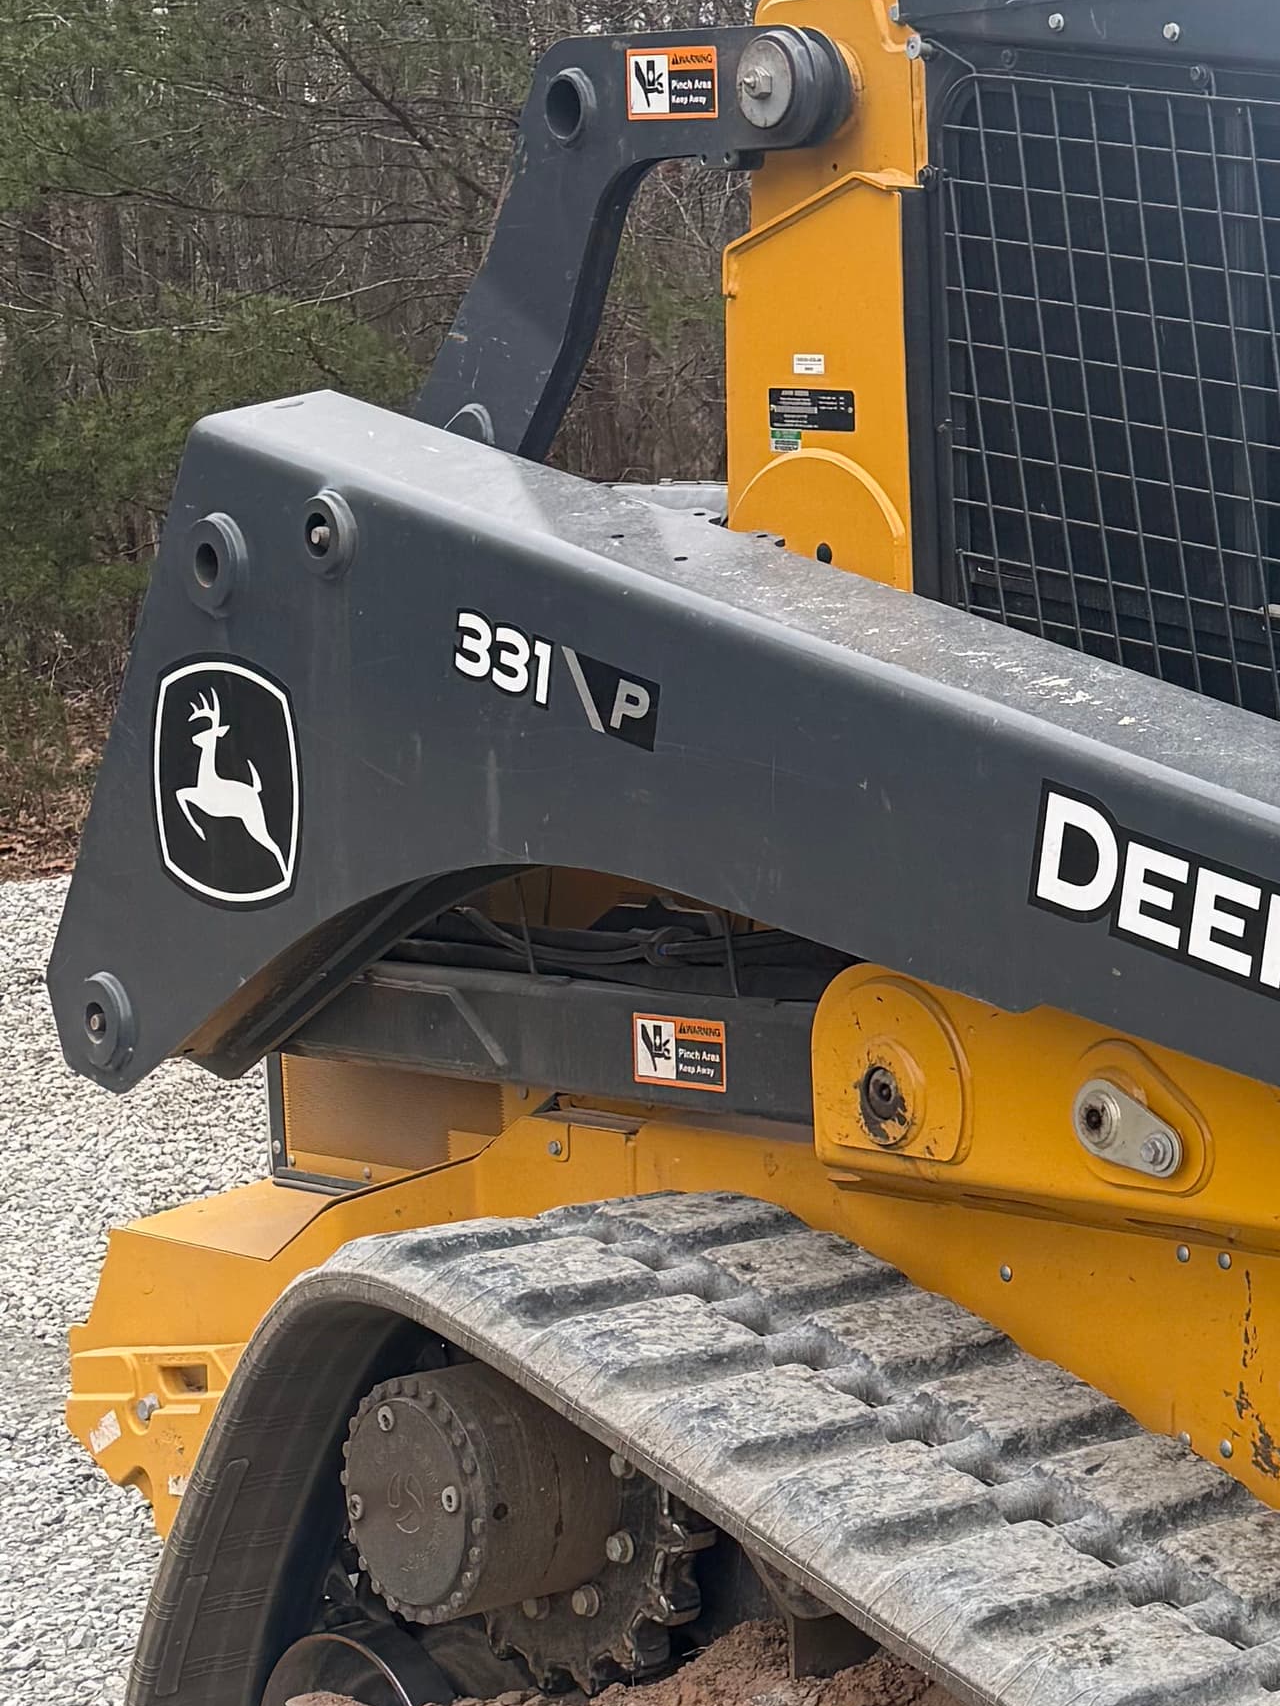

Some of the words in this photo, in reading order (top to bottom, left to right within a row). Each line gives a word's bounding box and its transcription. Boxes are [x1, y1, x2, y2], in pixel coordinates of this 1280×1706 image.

[671, 79, 693, 90] Pinch
[694, 79, 712, 90] Area
[671, 94, 688, 105] Keep
[689, 94, 707, 105] Away
[455, 612, 552, 705] 331
[609, 678, 651, 730] P
[685, 1024, 721, 1038] WARNING
[678, 1047, 701, 1061] Pinch
[701, 1050, 721, 1063] Area
[678, 1063, 696, 1075] Keep
[696, 1065, 715, 1078] Away
